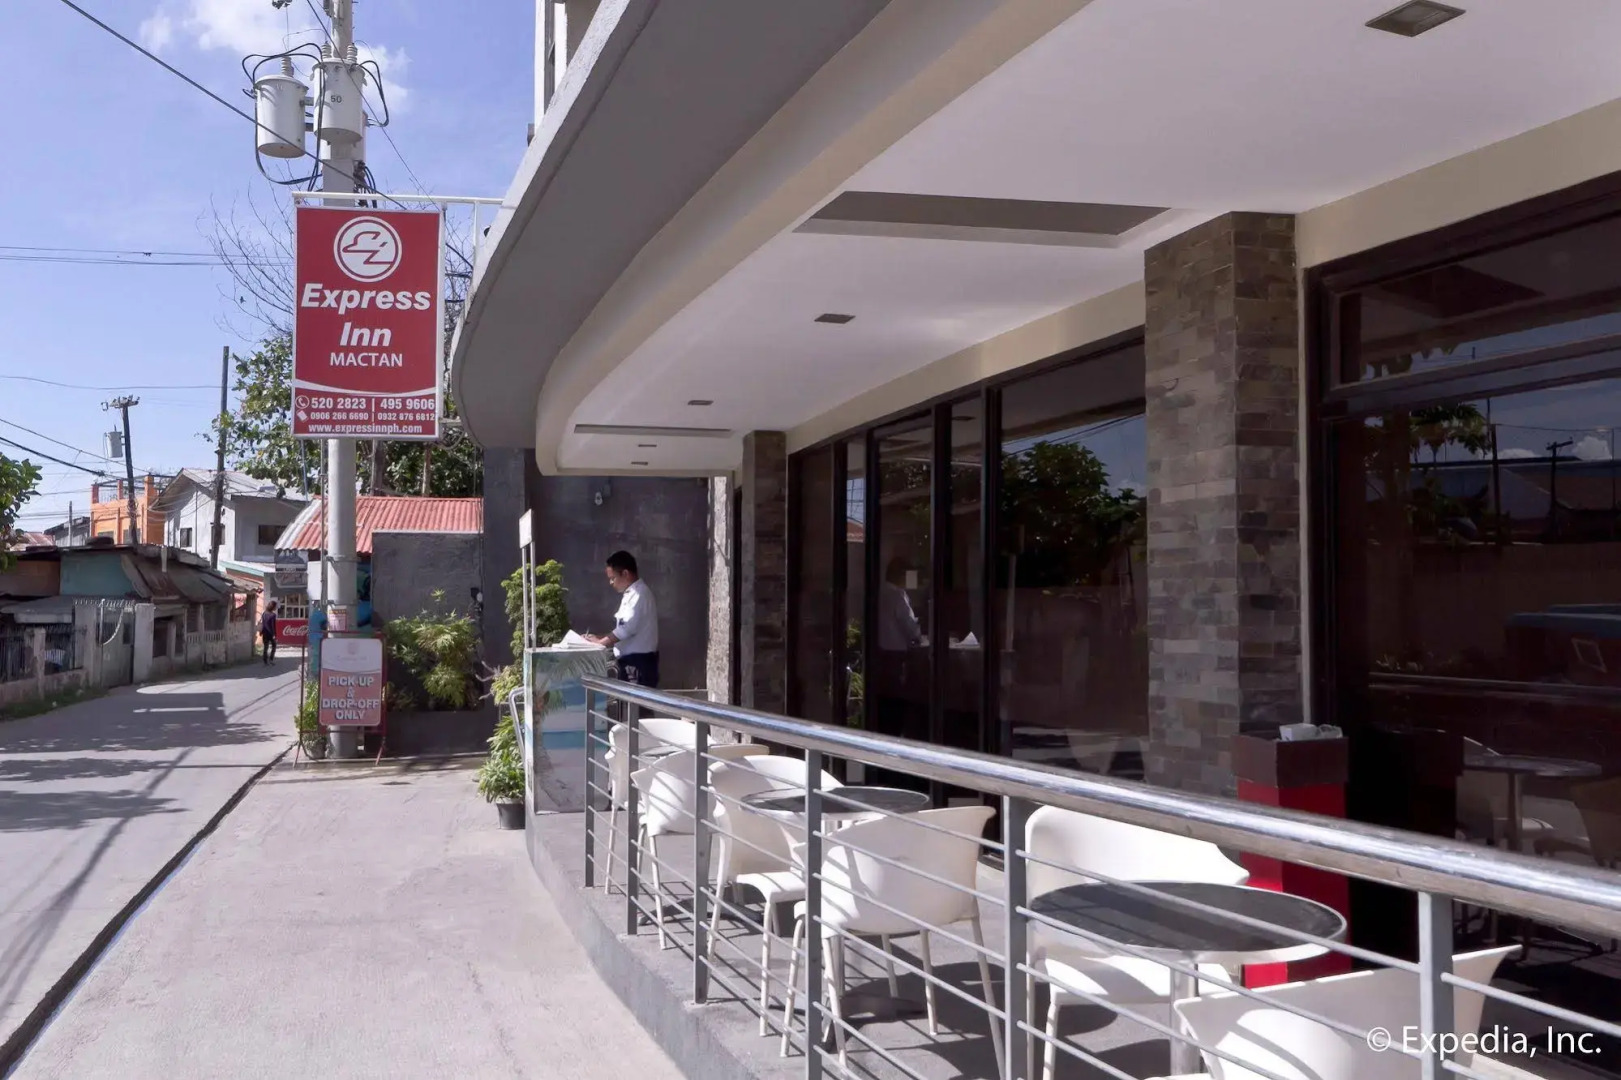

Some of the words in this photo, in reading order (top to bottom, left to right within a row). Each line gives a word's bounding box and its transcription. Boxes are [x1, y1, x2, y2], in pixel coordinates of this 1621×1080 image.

[330, 95, 342, 104] 50
[301, 283, 431, 315] Express
[339, 322, 392, 347] Inn
[330, 352, 403, 367] MACTAN
[311, 397, 333, 409] 520
[337, 398, 366, 409] 2823
[380, 398, 402, 410] 495
[406, 398, 435, 410] 9606
[377, 412, 397, 421] 0932
[415, 412, 435, 421] 6812
[308, 423, 422, 434] www.expressinnph.com
[346, 687, 355, 699] &
[322, 699, 380, 709] DROP-OFF
[335, 710, 365, 720] ONLY
